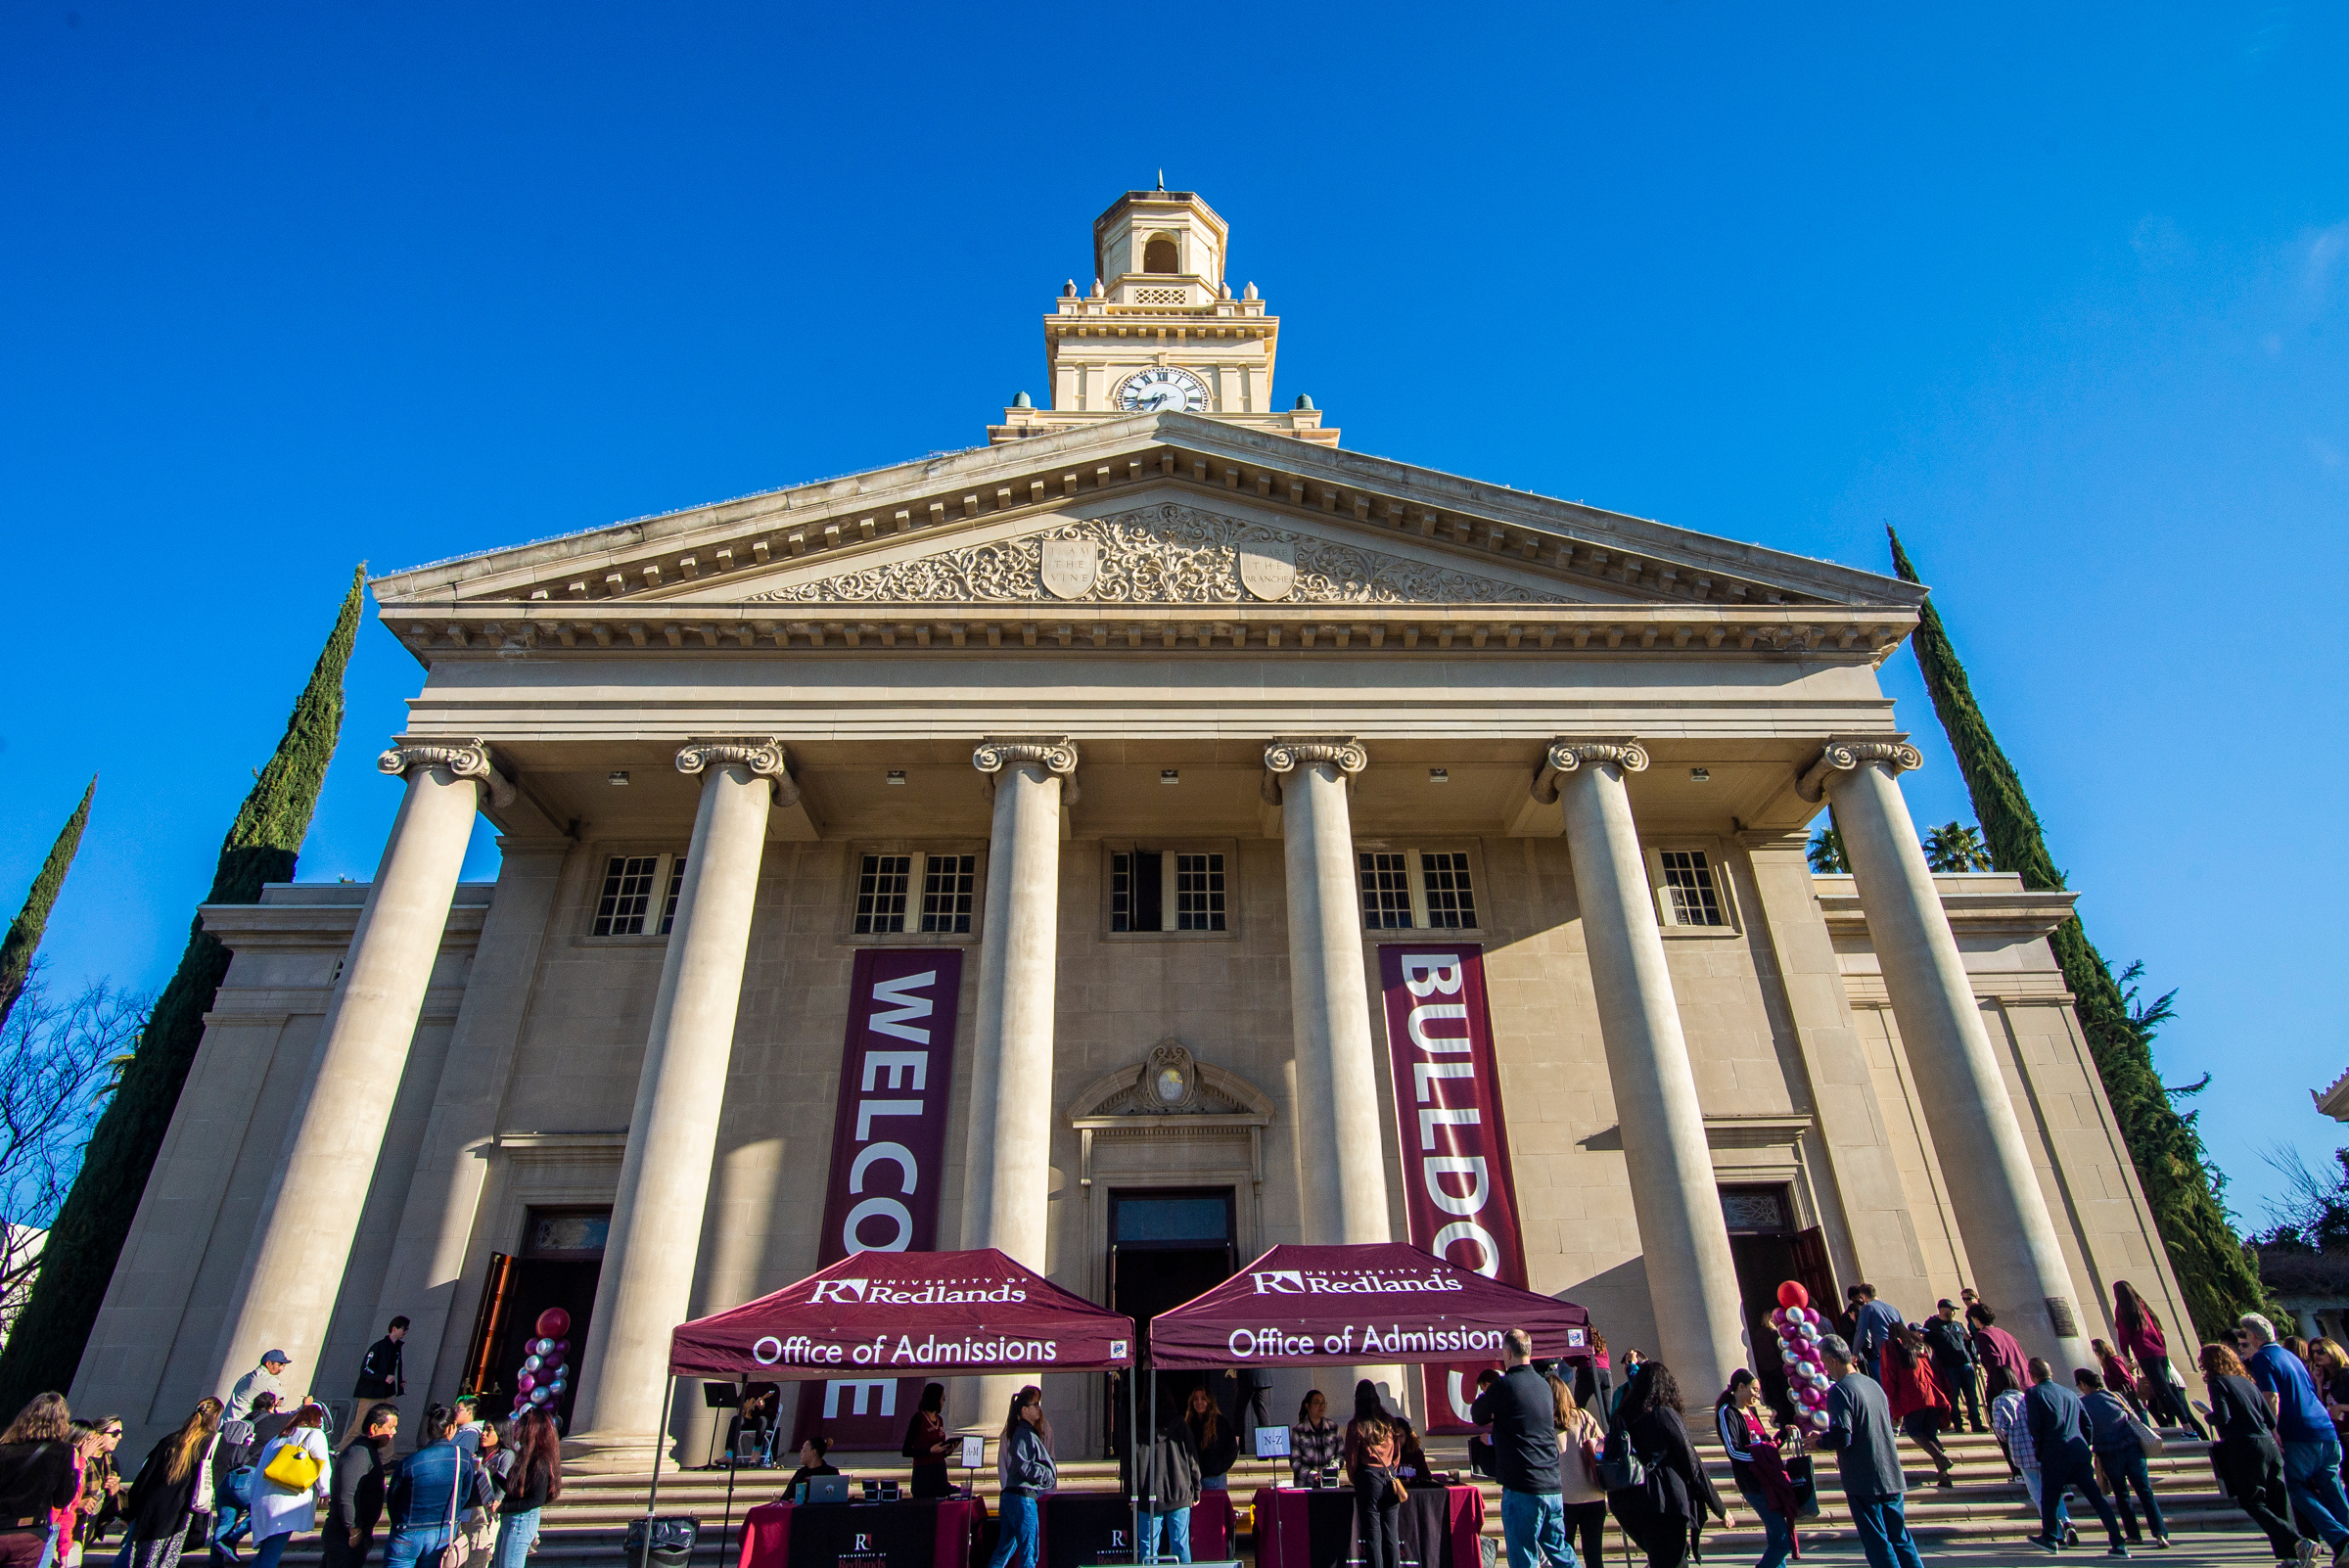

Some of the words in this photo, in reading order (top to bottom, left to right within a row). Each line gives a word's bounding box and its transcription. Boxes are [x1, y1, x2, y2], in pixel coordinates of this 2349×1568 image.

[1156, 372, 1168, 382] XII
[1054, 560, 1084, 569] THE
[1051, 574, 1088, 582] VINE
[1245, 575, 1294, 583] BRANCHES
[823, 970, 937, 1419] WELCOE
[1307, 1274, 1463, 1294] Redlands
[865, 1284, 1027, 1304] Redlands
[1228, 1327, 1315, 1359] Office
[1323, 1325, 1355, 1355] of
[1360, 1324, 1508, 1353] Admission
[753, 1335, 843, 1365] Office
[852, 1334, 888, 1364] of
[891, 1334, 1057, 1364] Admissions
[1264, 1435, 1283, 1446] N-Z
[966, 1447, 979, 1456] A-M
[838, 1558, 886, 1568] Redlands
